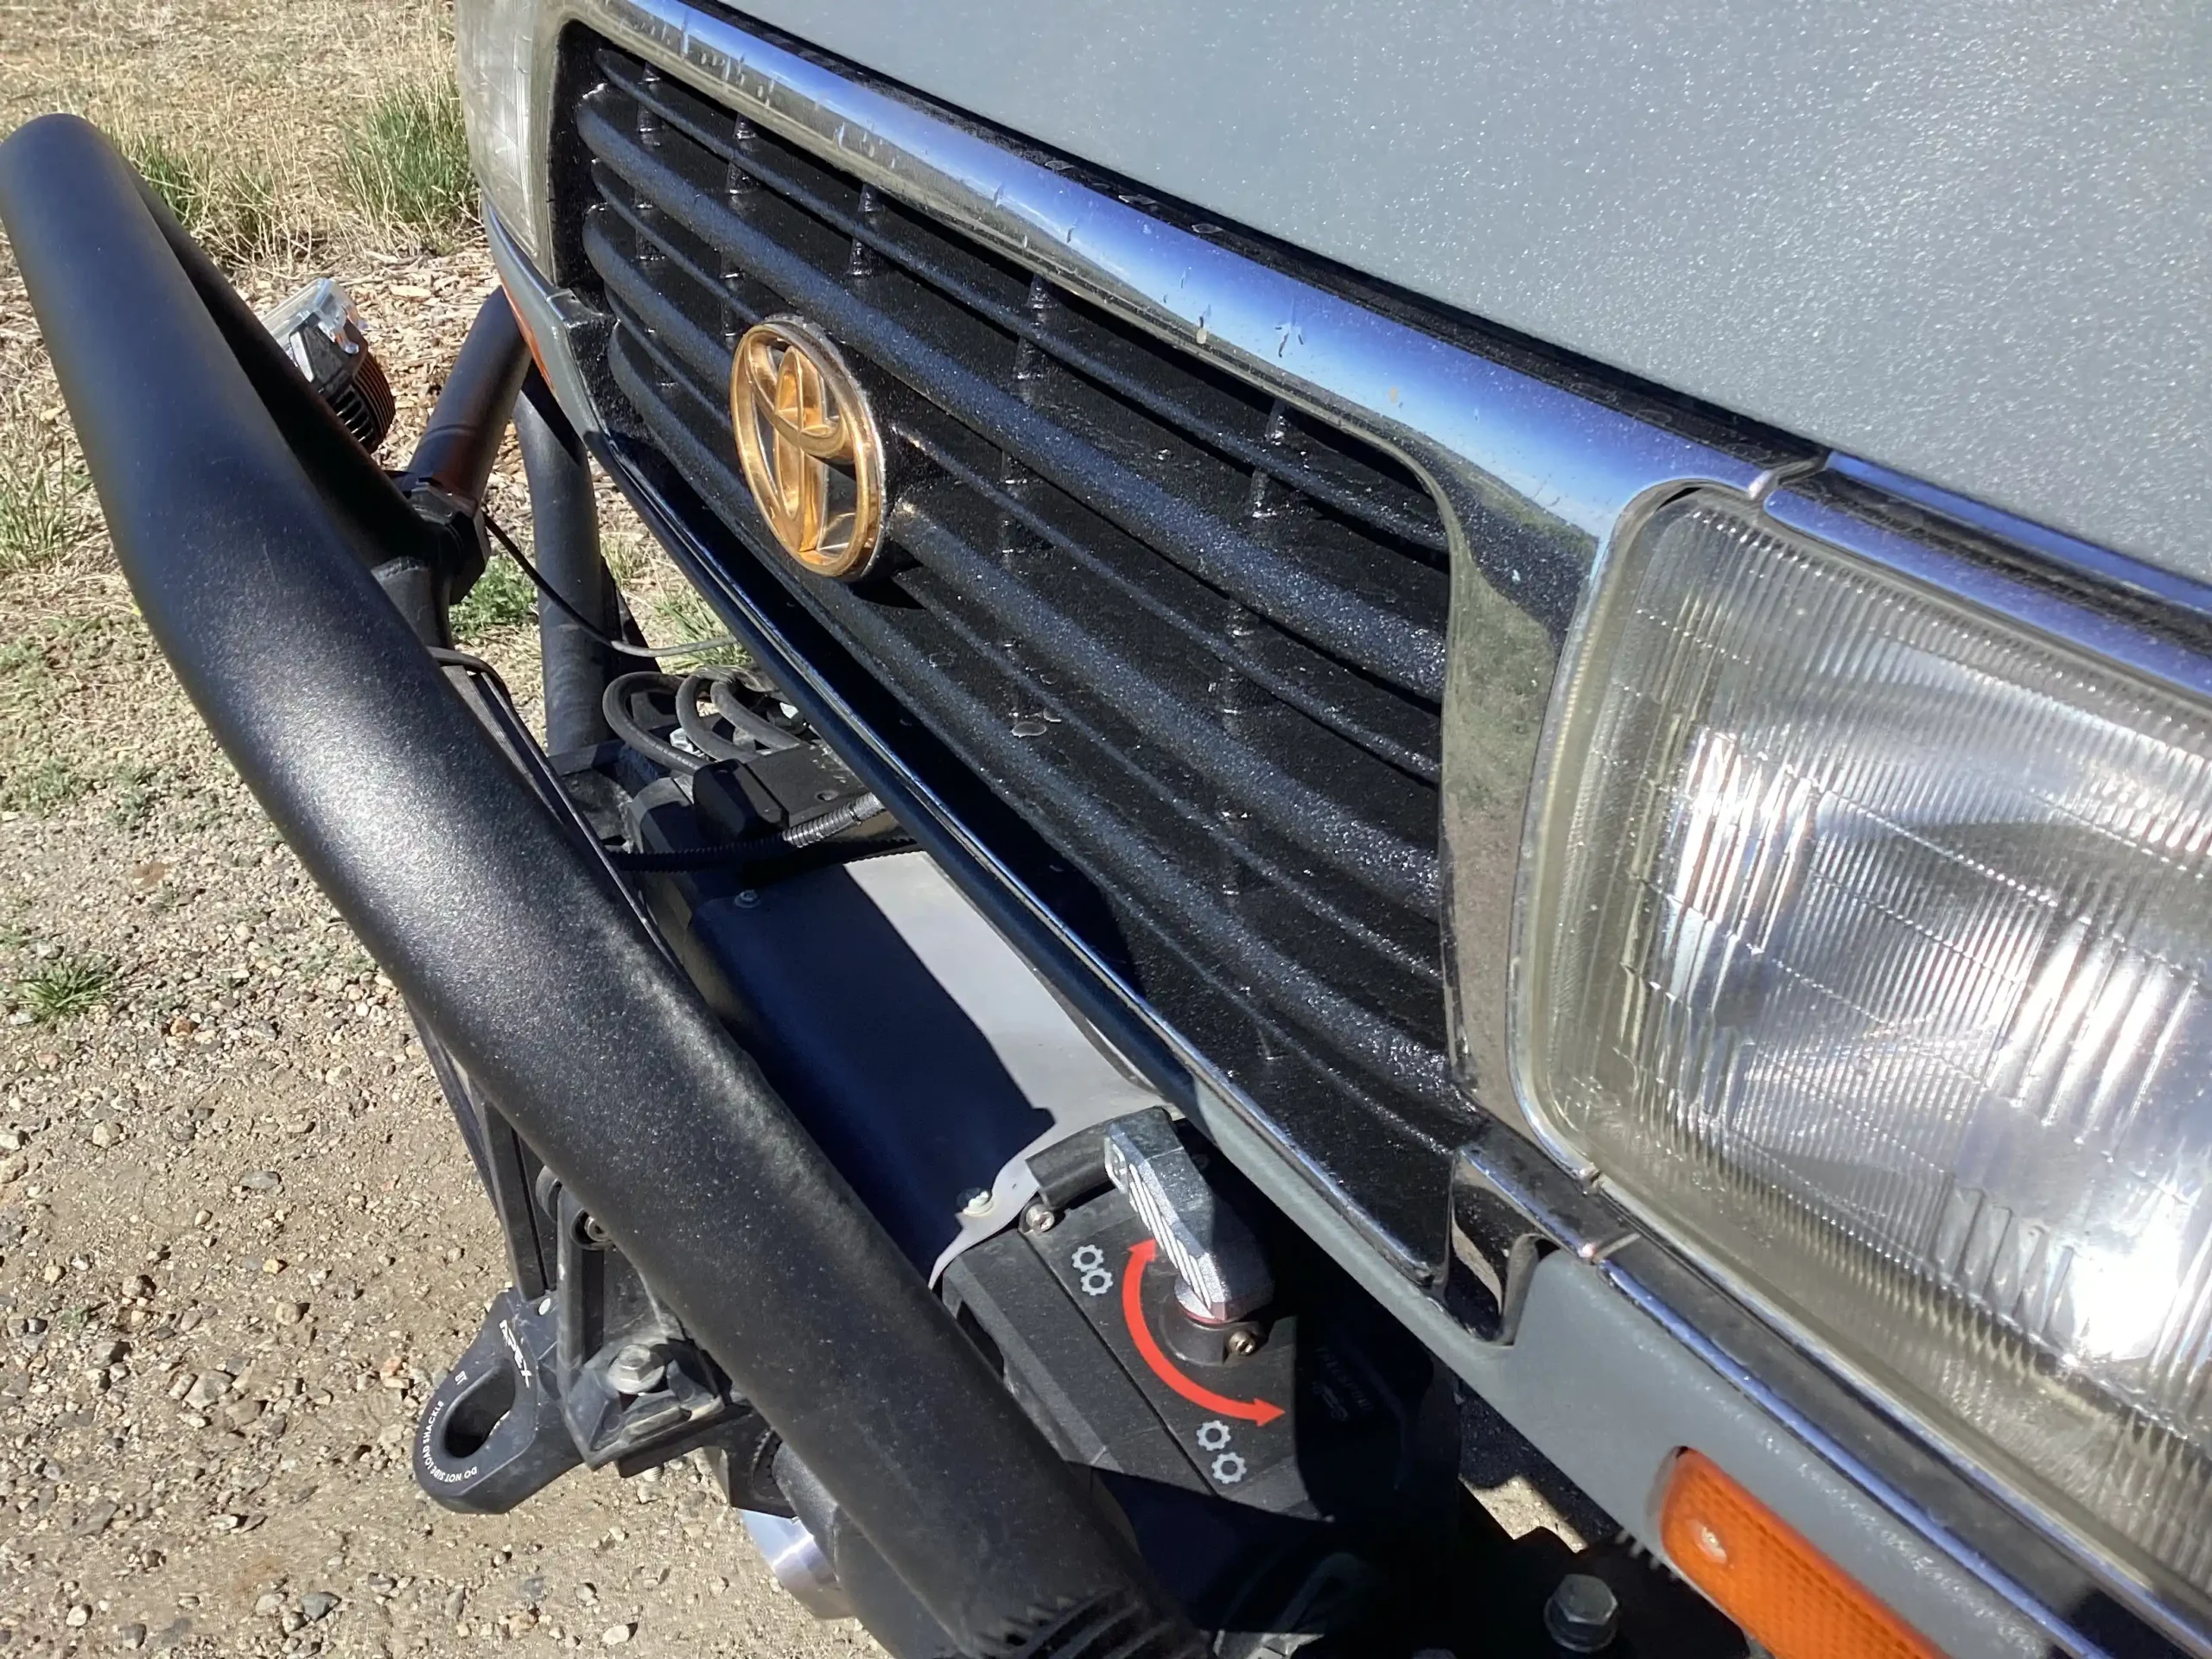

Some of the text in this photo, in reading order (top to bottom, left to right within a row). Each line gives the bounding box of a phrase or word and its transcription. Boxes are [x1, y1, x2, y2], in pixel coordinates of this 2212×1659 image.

[499, 1319, 532, 1389] APEX
[423, 1401, 477, 1483] DO NOT SIDE LOAD SHACKLE
